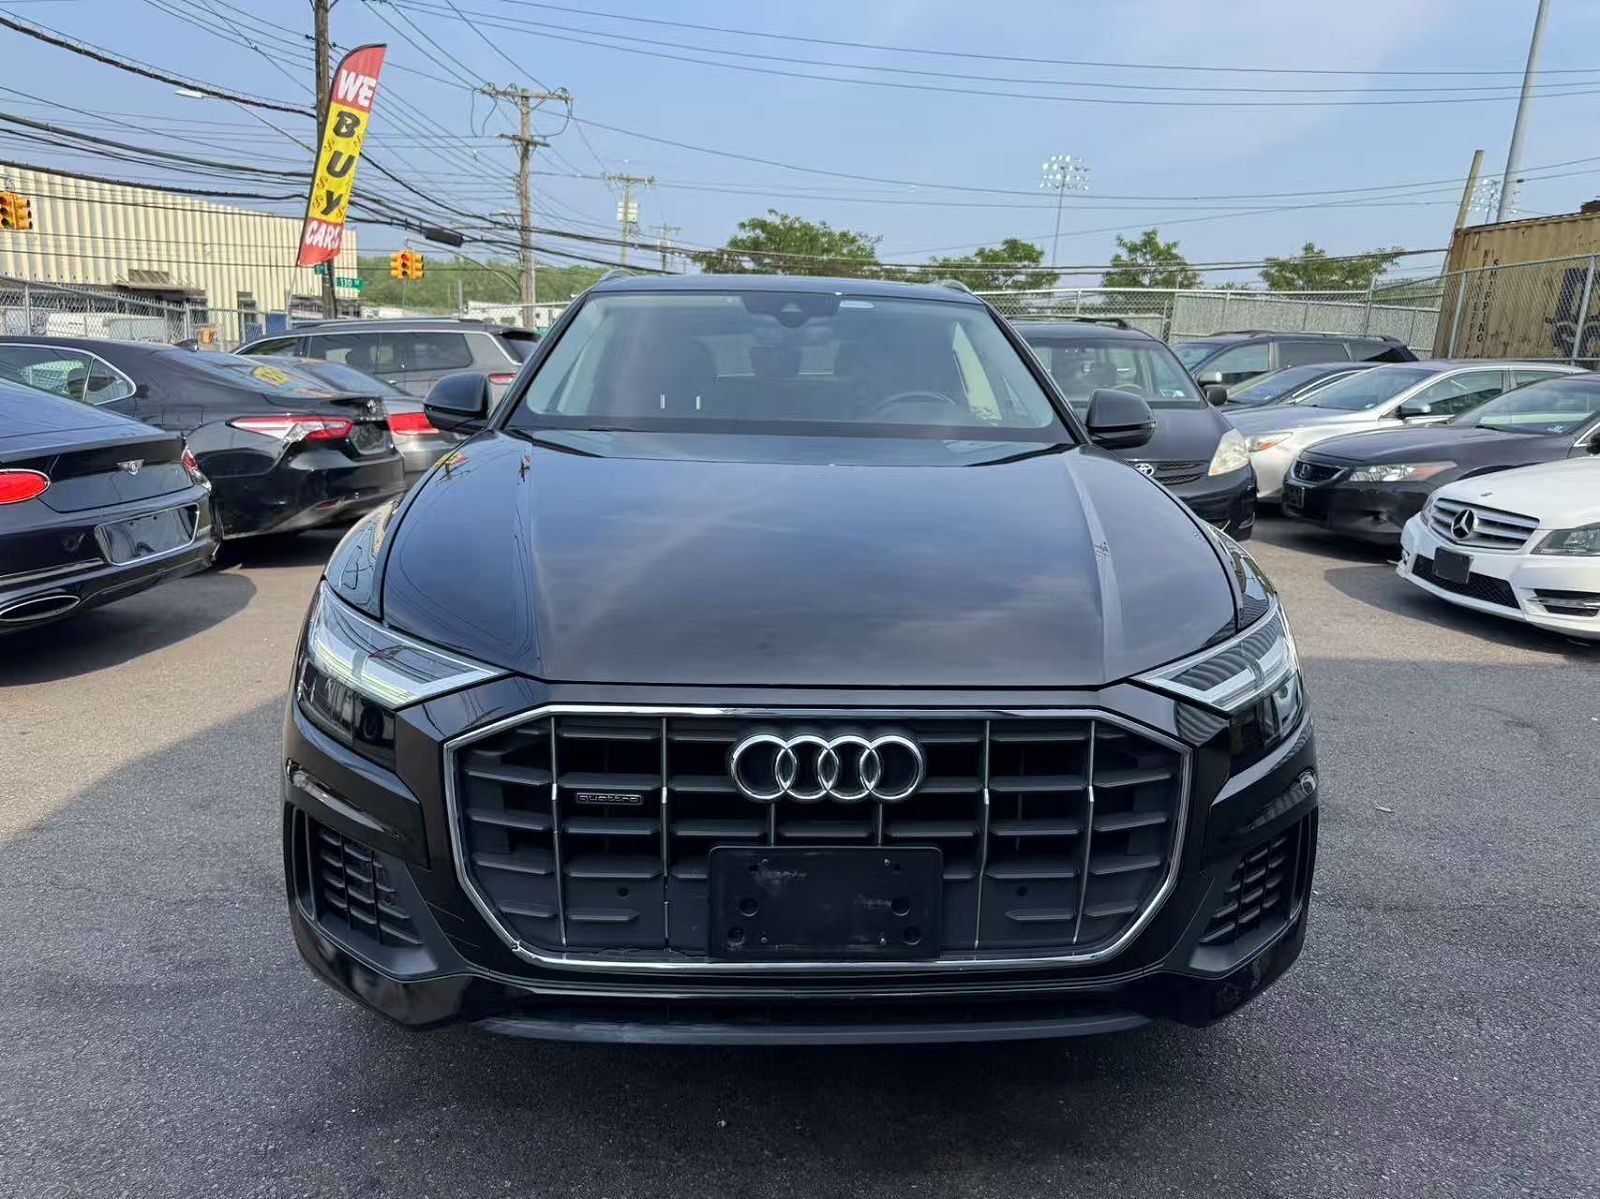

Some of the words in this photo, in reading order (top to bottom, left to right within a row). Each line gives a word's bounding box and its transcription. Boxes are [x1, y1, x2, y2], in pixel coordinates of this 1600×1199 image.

[337, 68, 377, 107] WE
[321, 110, 361, 216] BUY
[305, 219, 340, 250] CARS
